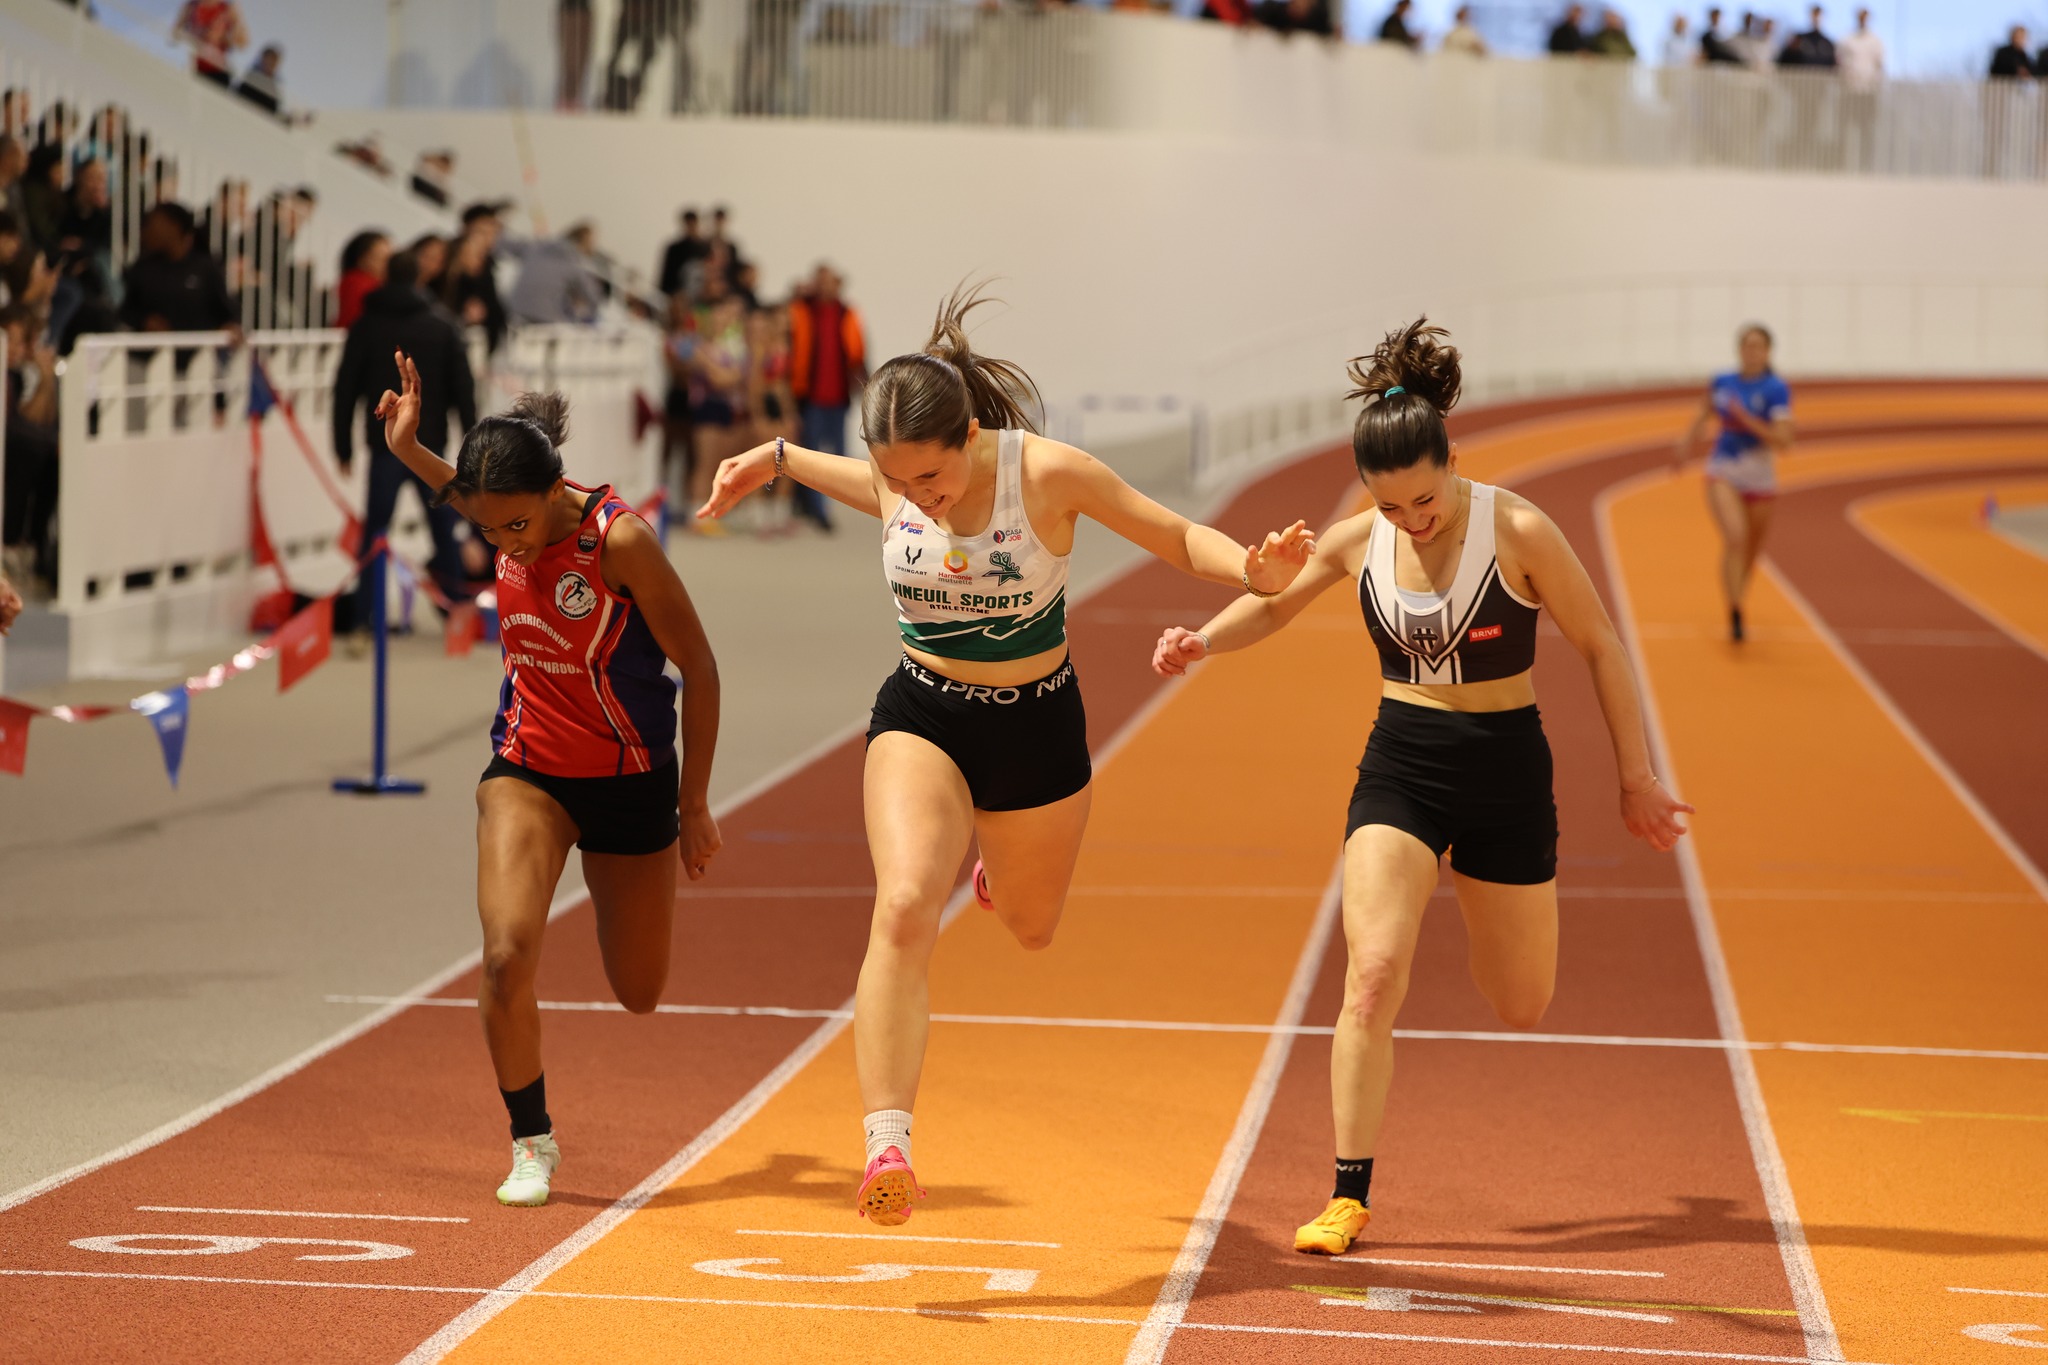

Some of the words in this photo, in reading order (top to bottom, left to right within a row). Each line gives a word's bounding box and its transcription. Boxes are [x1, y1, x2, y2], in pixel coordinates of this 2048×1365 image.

[907, 527, 923, 536] SPORT
[908, 522, 925, 530] INTER
[580, 534, 598, 542] SPORT
[505, 570, 527, 586] MAISON
[938, 571, 973, 581] Harmonie
[938, 577, 973, 586] mutuelle
[891, 580, 952, 604] VINEUIL
[960, 590, 1034, 609] SPORTS
[929, 604, 990, 615] ATHLETISME
[501, 617, 512, 631] LA
[509, 613, 574, 651] BERRICHONNE
[941, 679, 1021, 705] PRO
[690, 1256, 1042, 1293] 5
